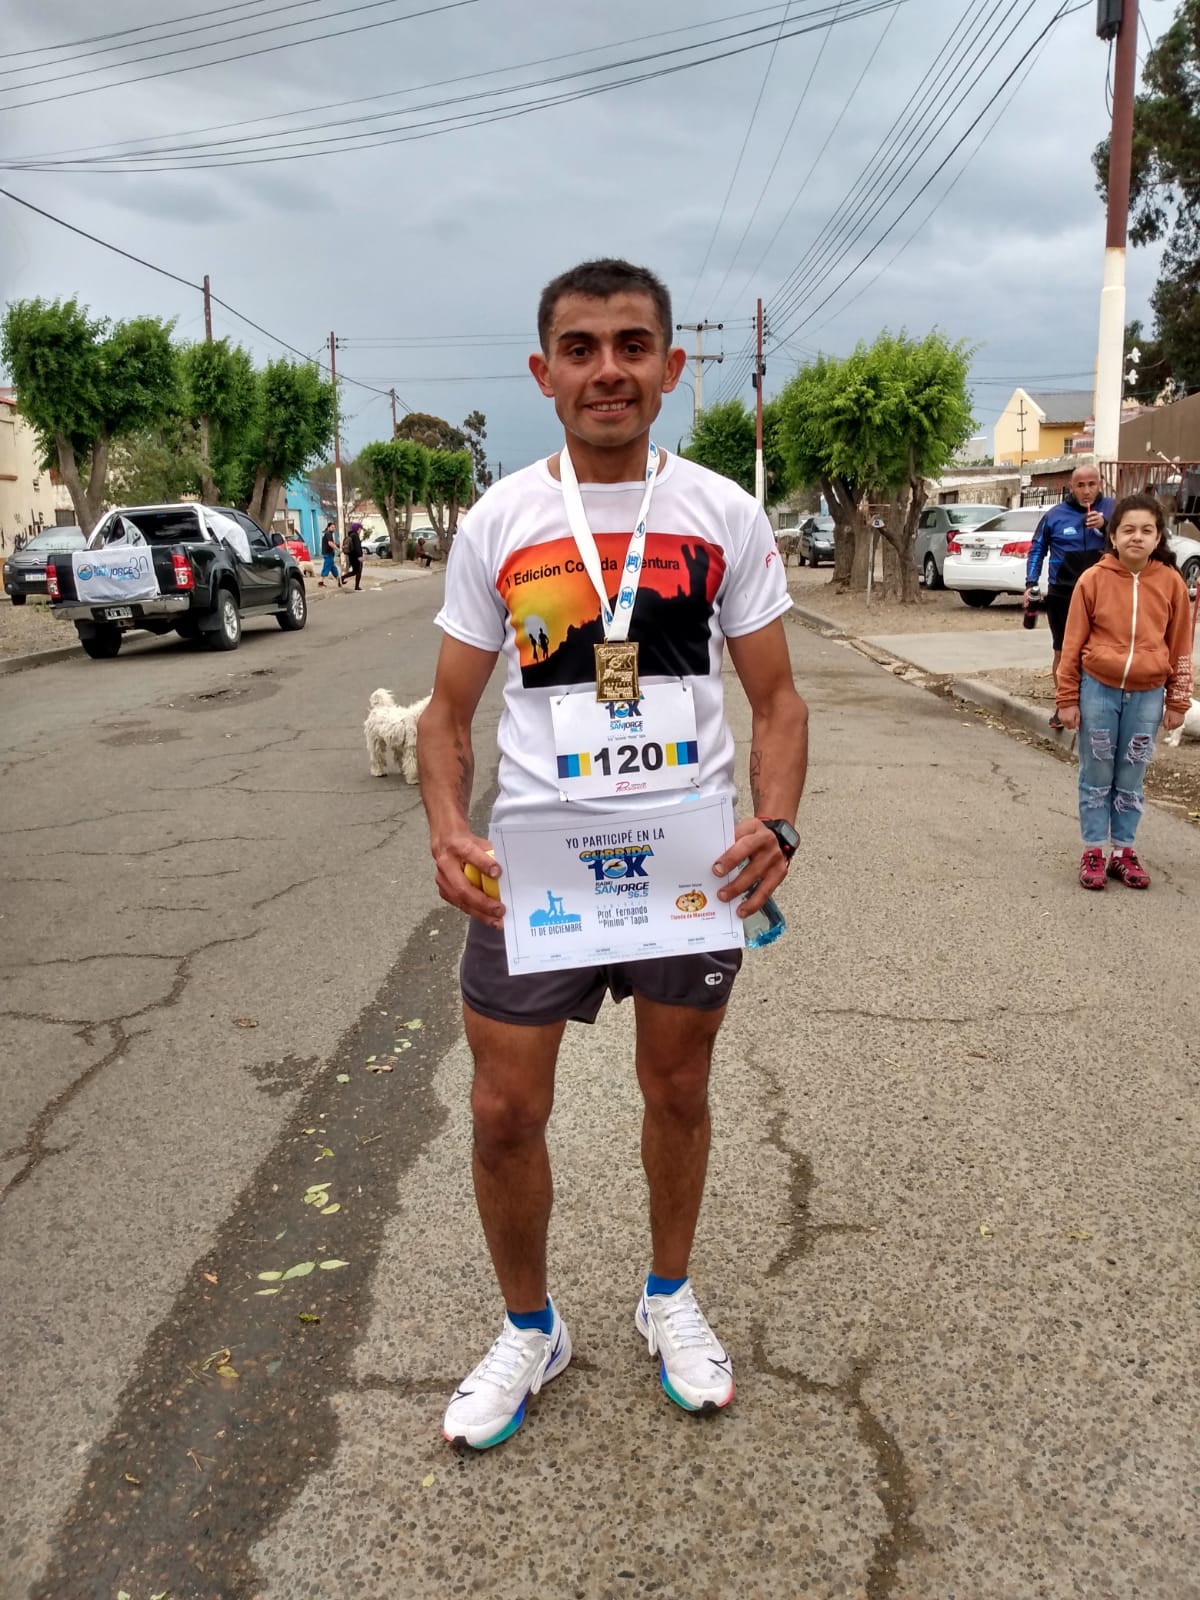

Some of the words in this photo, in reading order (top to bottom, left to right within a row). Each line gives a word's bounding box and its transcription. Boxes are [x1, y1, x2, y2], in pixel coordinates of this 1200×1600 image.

[514, 564, 561, 586] Edición
[564, 559, 618, 574] Coda
[594, 742, 663, 776] 120
[565, 838, 579, 849] YO
[582, 830, 634, 848] PARTICIPÉ
[637, 829, 649, 842] EN
[653, 827, 665, 840] LA
[579, 844, 655, 863] CORRIDA
[588, 855, 649, 881] 10K
[615, 905, 648, 917] Fernando
[630, 915, 649, 926] Tapia
[531, 927, 537, 937] 11
[539, 926, 547, 936] DE
[549, 922, 583, 935] DICIEMBRE
